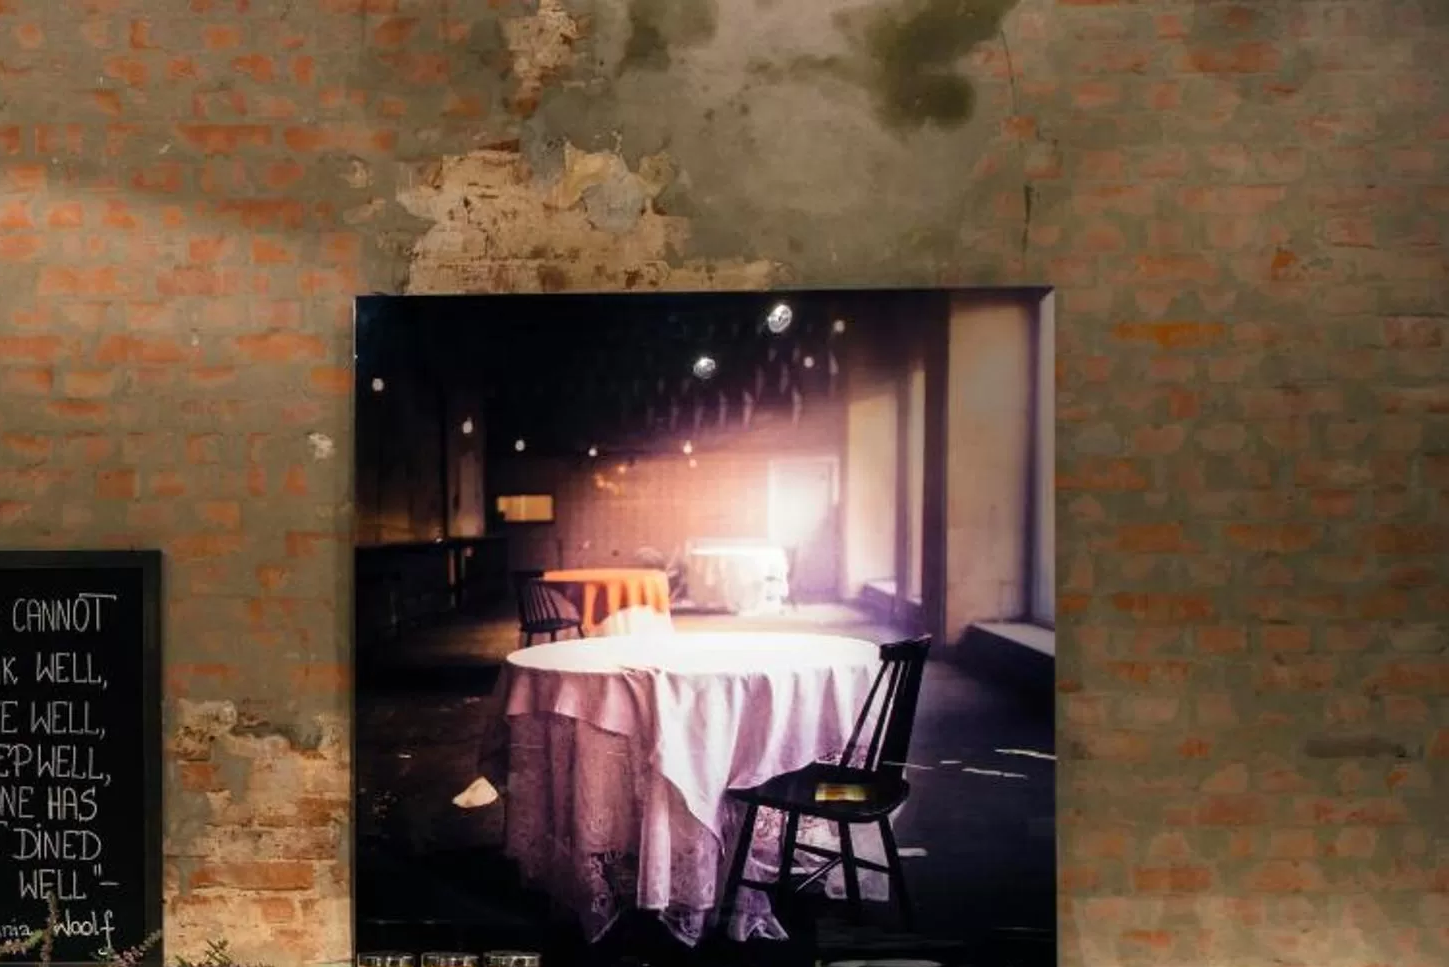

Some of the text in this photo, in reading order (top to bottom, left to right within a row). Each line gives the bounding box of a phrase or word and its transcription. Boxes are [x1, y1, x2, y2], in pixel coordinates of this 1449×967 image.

[12, 592, 117, 632] CANNOT
[35, 651, 107, 690] WELL,
[30, 700, 105, 740] WELL,
[37, 745, 111, 786] WELL,
[47, 785, 98, 822] HAS
